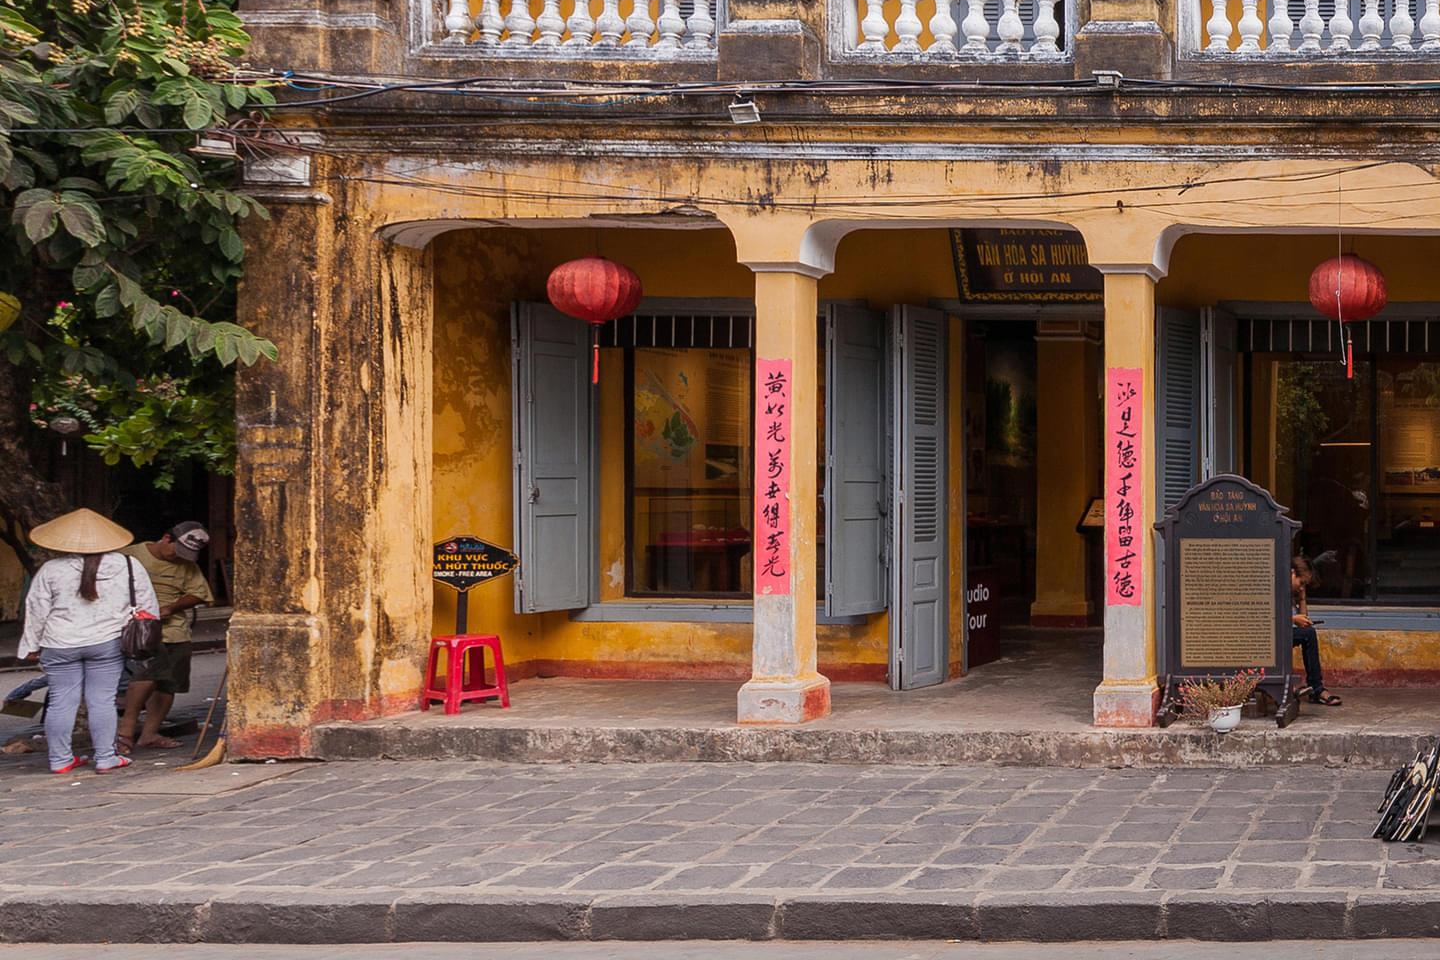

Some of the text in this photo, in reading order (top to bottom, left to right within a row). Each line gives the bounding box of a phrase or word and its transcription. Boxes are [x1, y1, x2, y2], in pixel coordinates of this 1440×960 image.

[1031, 244, 1047, 265] SA
[1051, 272, 1071, 284] AN
[445, 561, 467, 570] HÚT
[967, 583, 990, 604] udio
